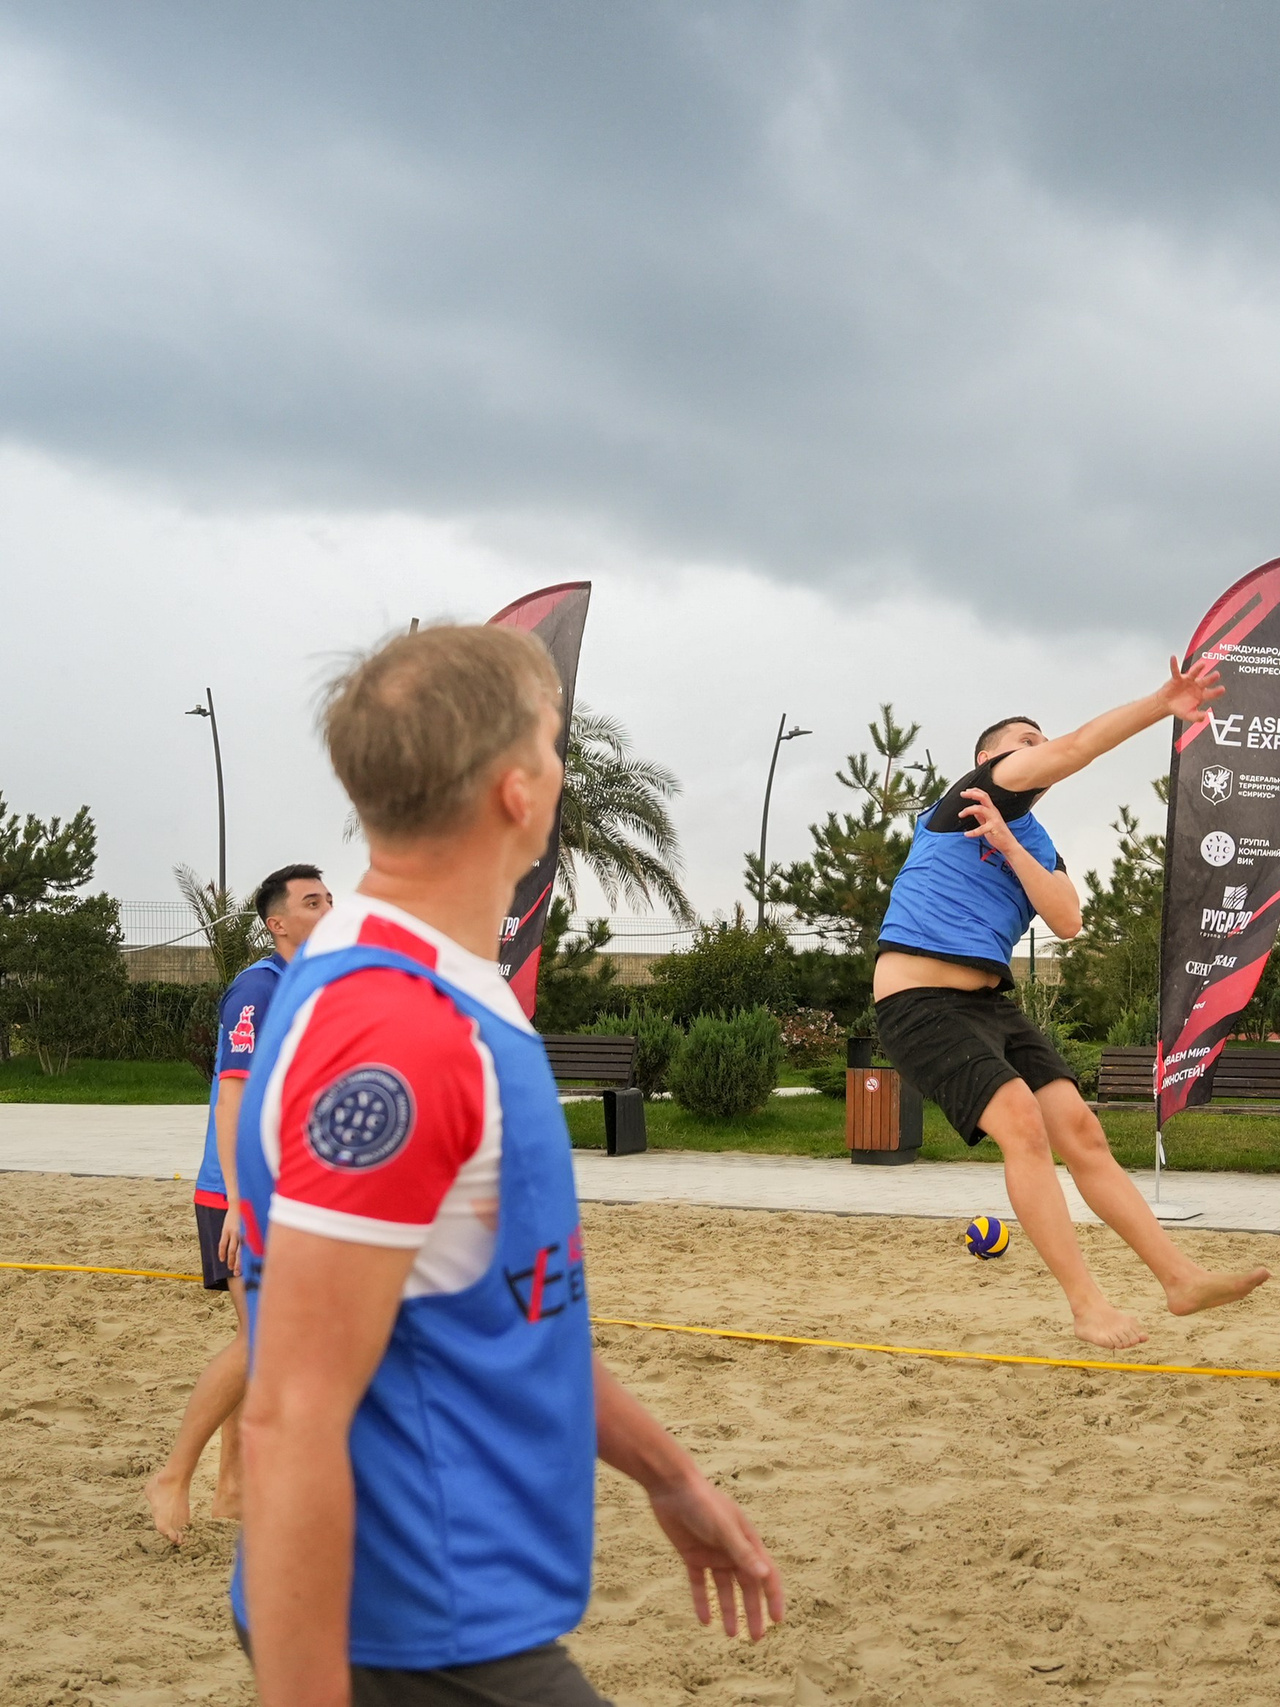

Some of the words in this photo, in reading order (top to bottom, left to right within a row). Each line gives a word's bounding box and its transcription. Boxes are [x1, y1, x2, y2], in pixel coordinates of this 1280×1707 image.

[1237, 790, 1276, 799] «СИРИУС»
[1239, 837, 1270, 847] ГРУППА
[1236, 857, 1255, 866] ВИК
[1187, 1046, 1211, 1059] МИР
